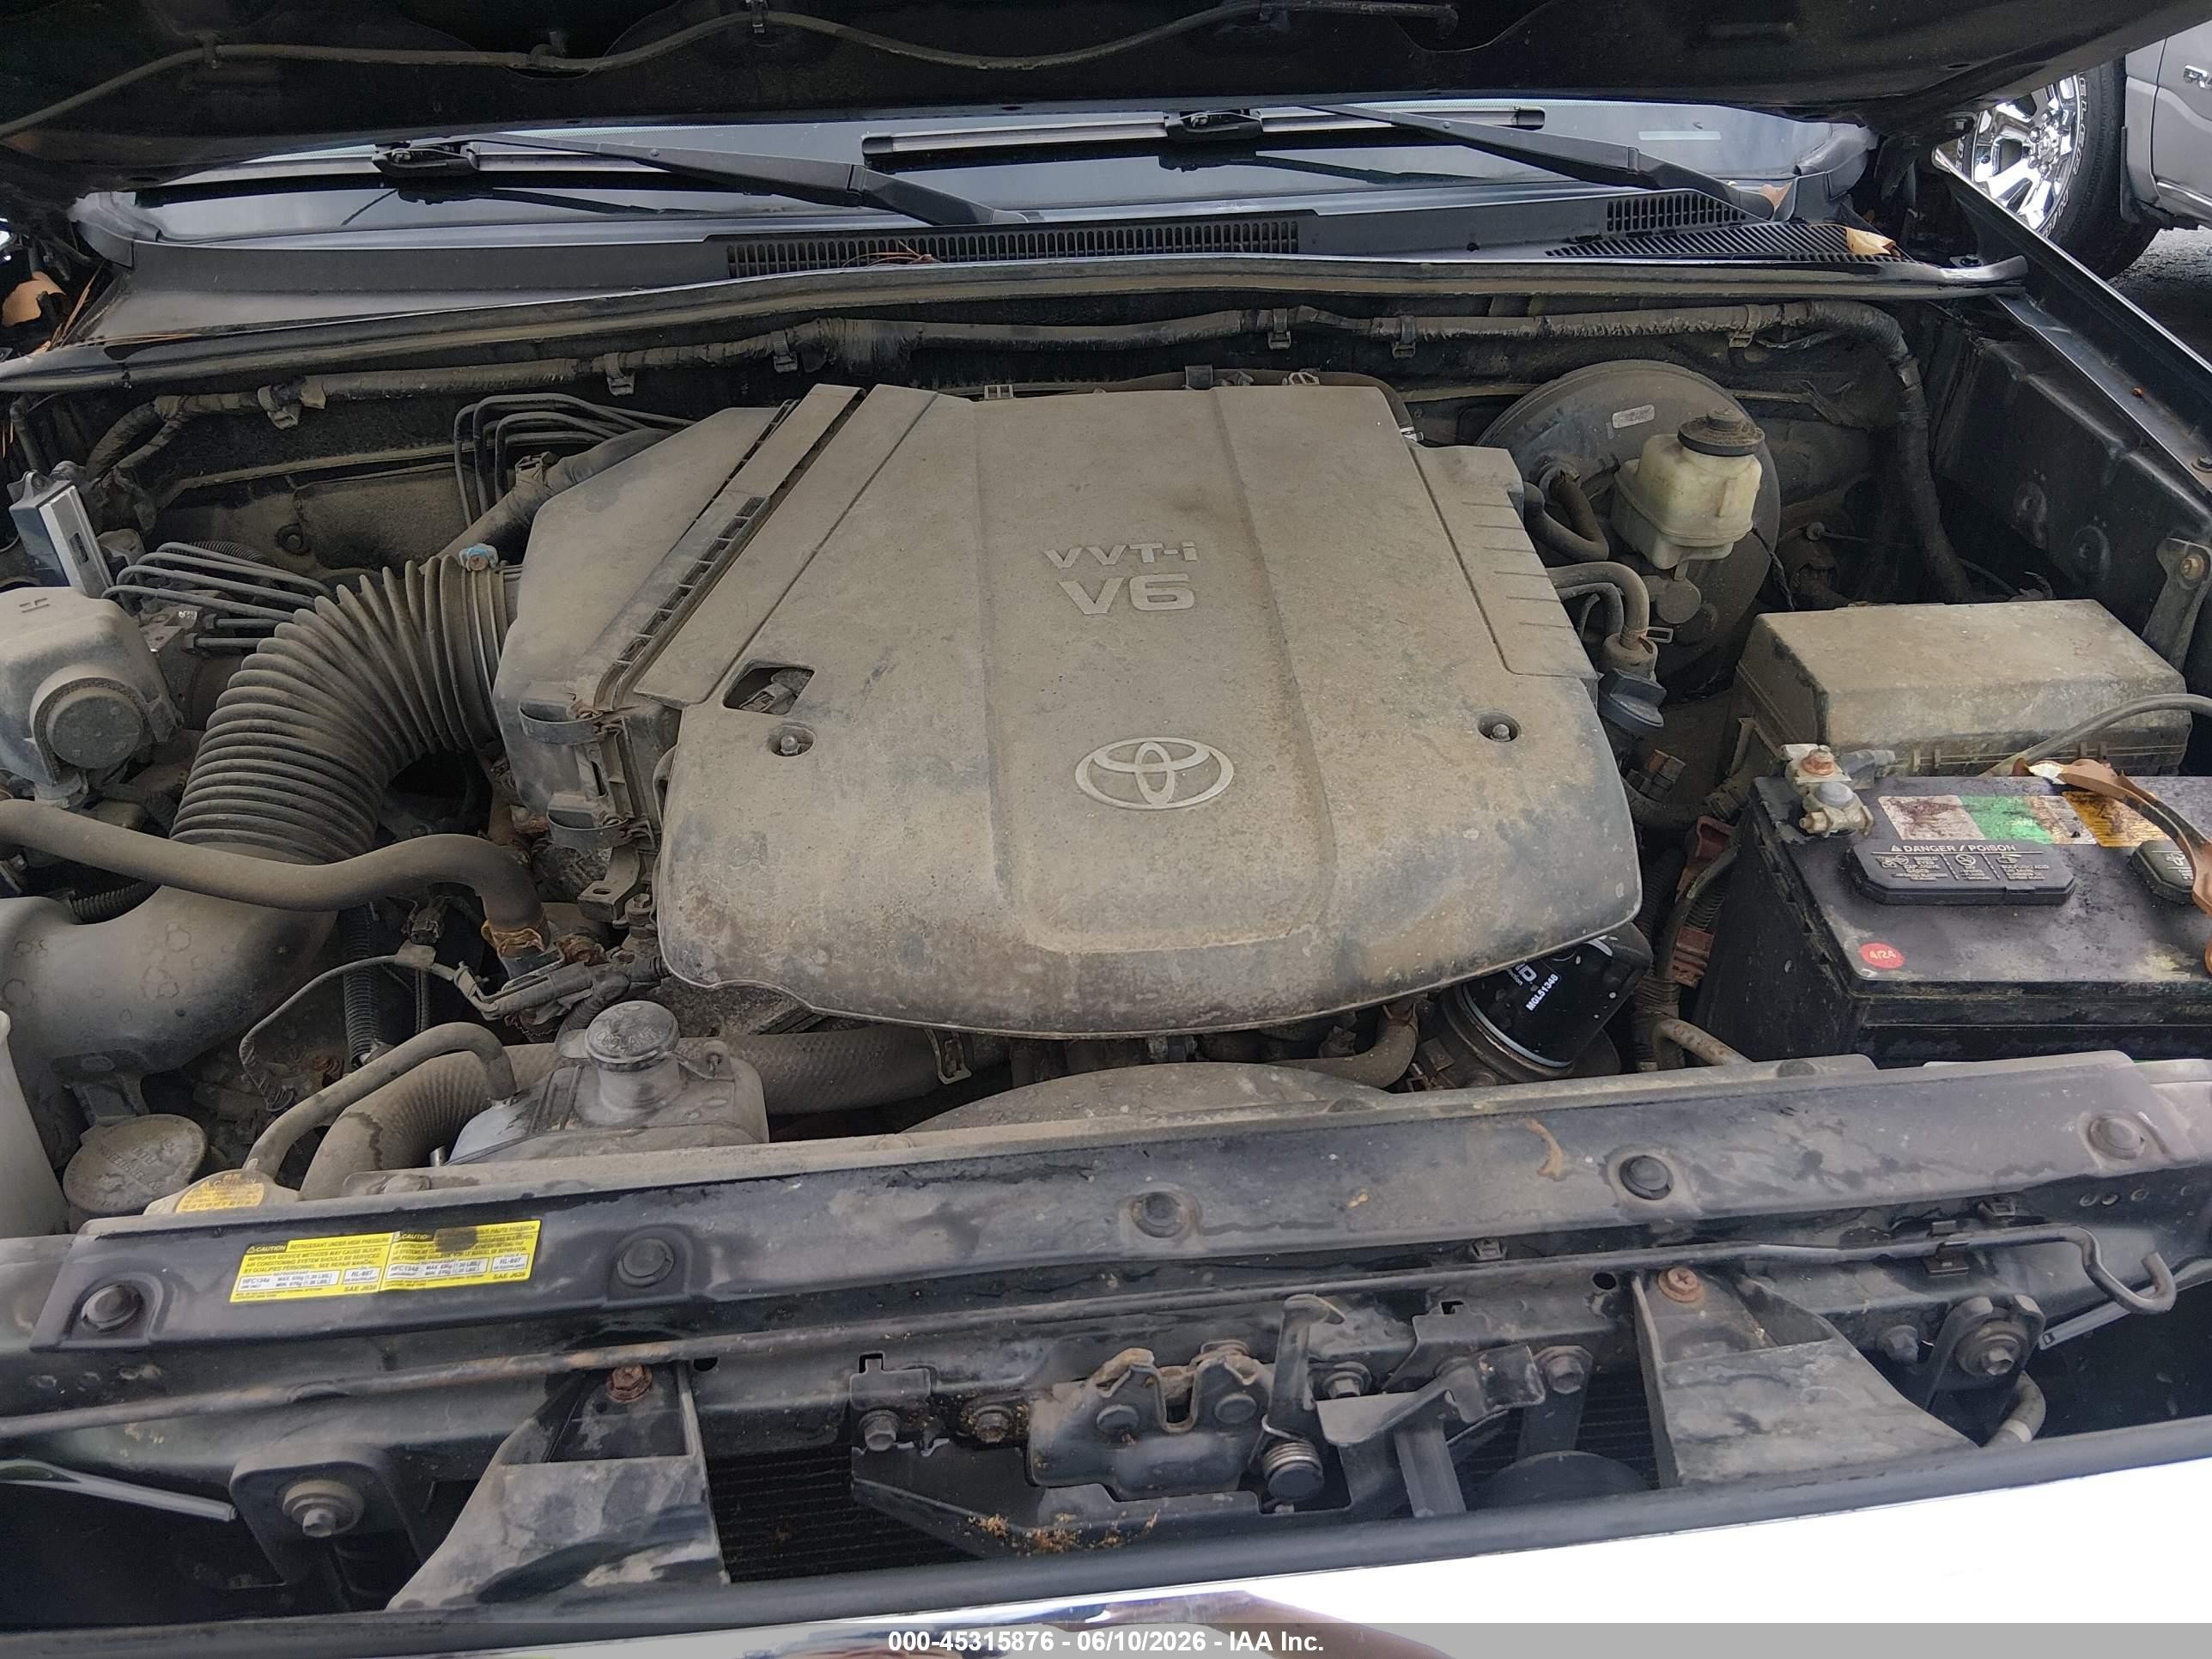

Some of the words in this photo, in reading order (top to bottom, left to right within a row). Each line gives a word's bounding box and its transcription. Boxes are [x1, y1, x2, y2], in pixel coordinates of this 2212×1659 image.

[1044, 542, 1198, 569] VVT-i
[1057, 573, 1196, 616] V6
[1525, 974, 1559, 1012] MGL51348
[254, 1244, 286, 1253] CAUTION
